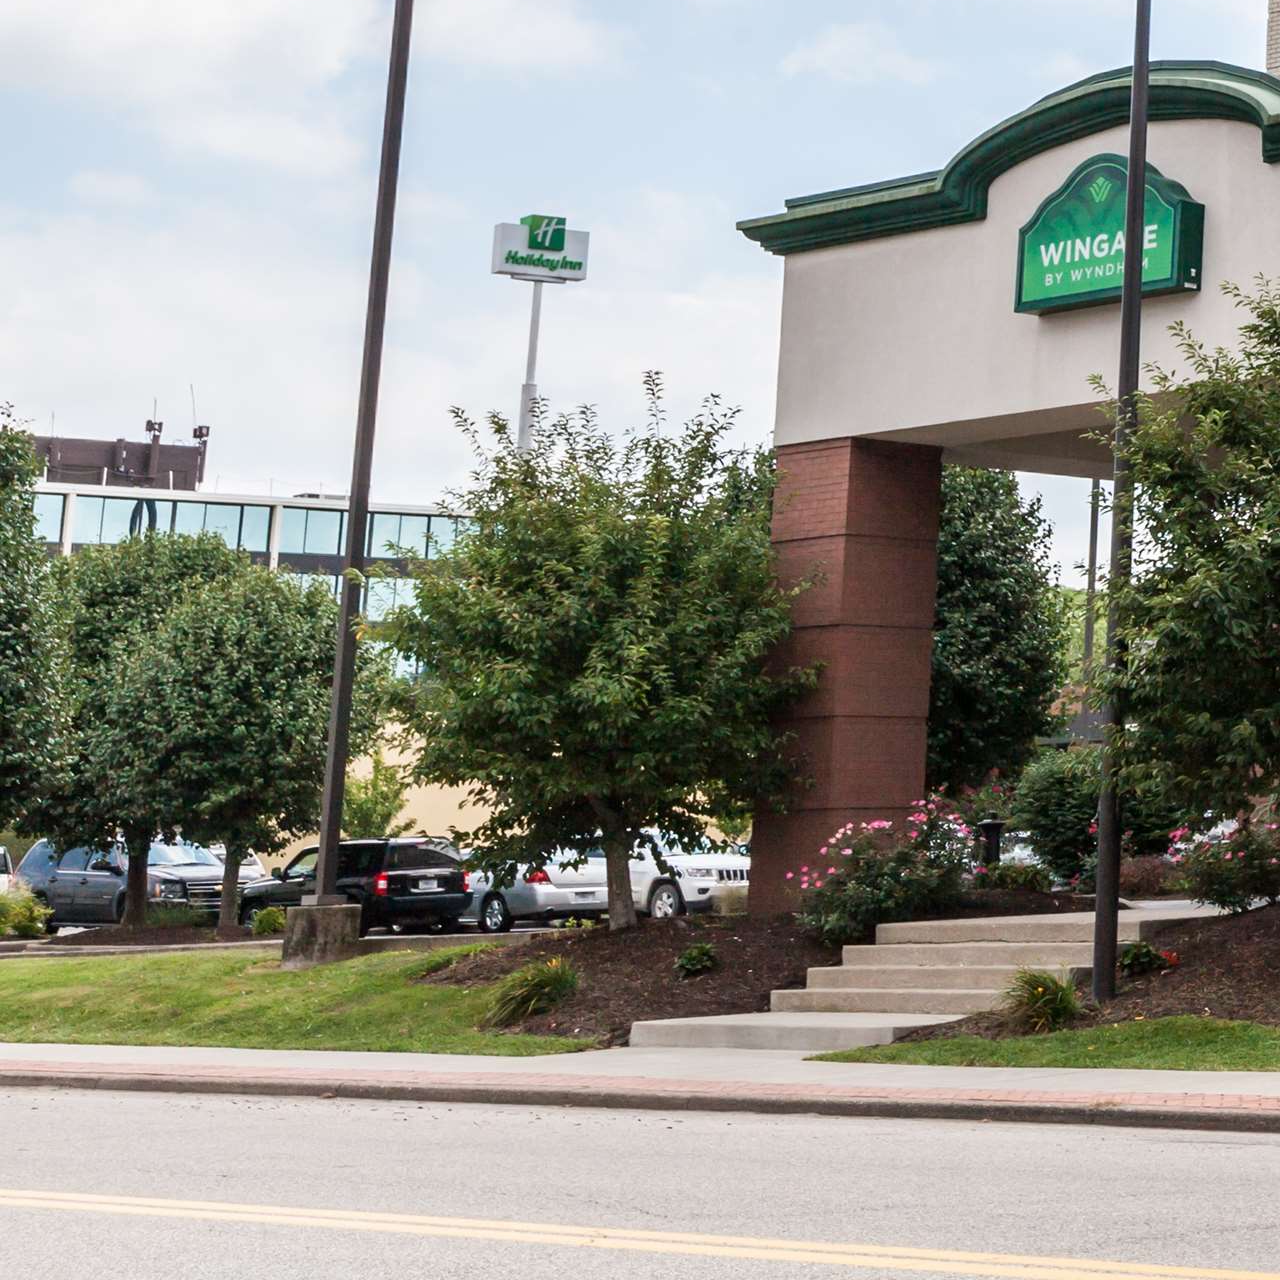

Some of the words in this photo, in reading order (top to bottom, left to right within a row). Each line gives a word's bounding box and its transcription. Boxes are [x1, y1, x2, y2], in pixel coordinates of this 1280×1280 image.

[1040, 224, 1158, 267] WINGAE
[505, 250, 560, 272] Holiday
[560, 255, 583, 271] Inn
[1044, 271, 1063, 286] BY
[1071, 257, 1148, 282] WYNDHM
